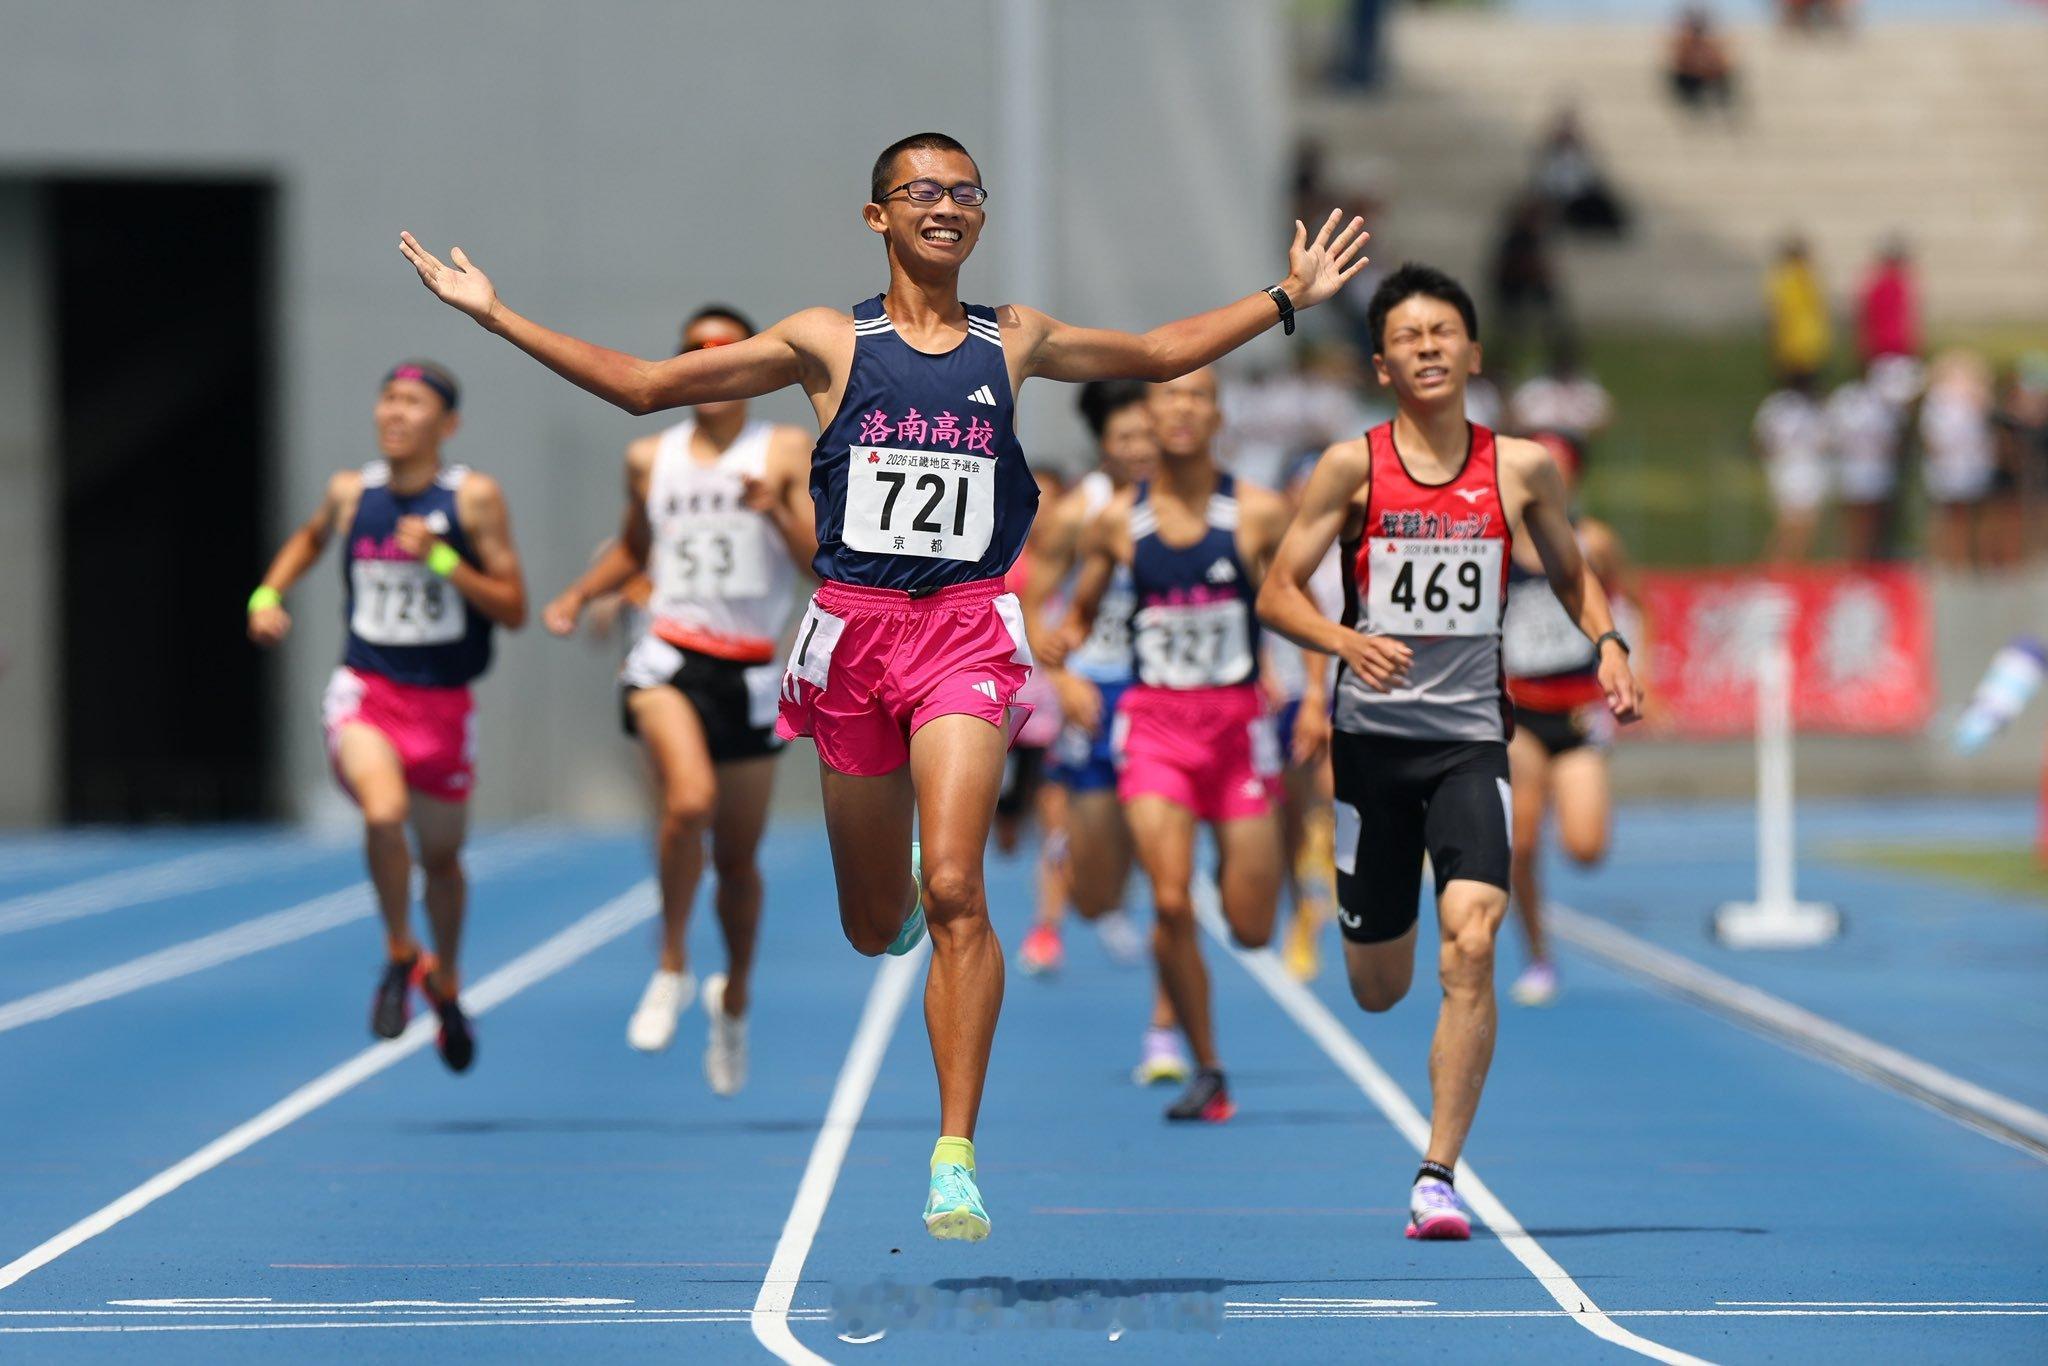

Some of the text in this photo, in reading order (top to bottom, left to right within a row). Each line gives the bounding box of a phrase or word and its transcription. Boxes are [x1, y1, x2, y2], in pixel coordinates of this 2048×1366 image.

[860, 408, 994, 456] 洛南高校
[886, 454, 981, 473] 2026近畿地区予選会
[876, 471, 969, 536] 721
[1391, 561, 1481, 613] 469
